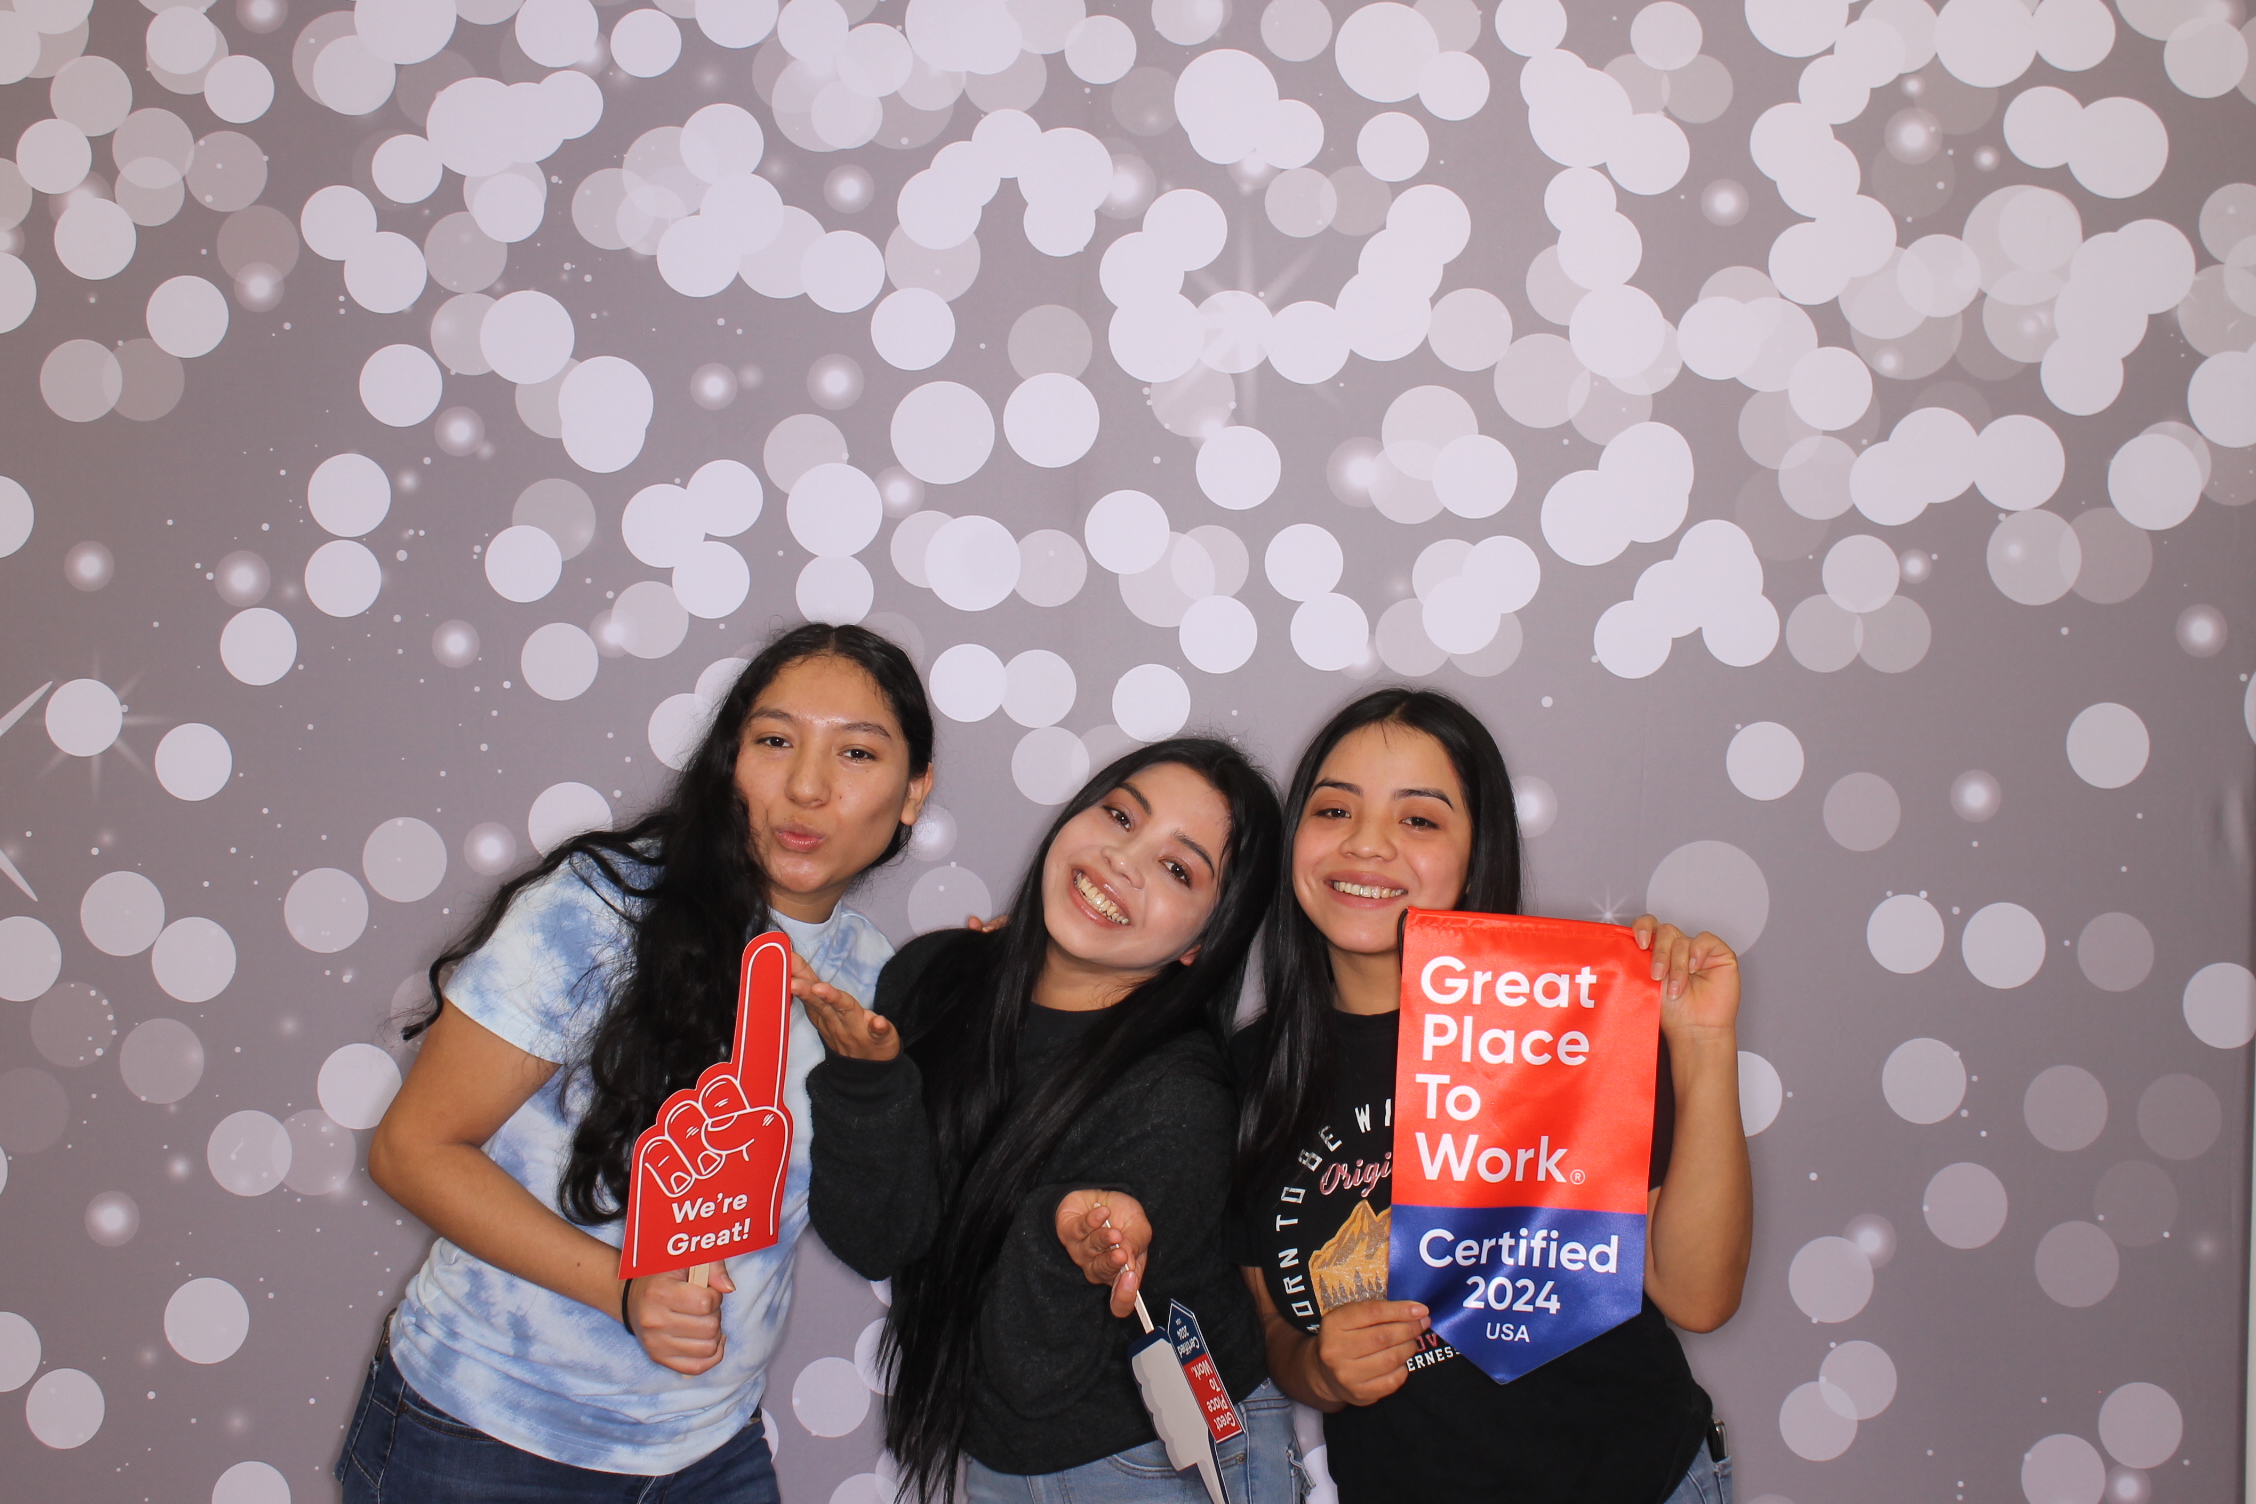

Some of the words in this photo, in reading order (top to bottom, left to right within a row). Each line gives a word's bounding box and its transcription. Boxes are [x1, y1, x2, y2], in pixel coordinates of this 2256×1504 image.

[1420, 955, 1597, 1009] Great
[1422, 1013, 1590, 1066] Place
[1415, 1073, 1481, 1121] To
[1275, 1186, 1306, 1232] TO
[1298, 1125, 1343, 1172] BE
[1354, 1098, 1392, 1133] WI
[1320, 1152, 1392, 1197] Origi
[671, 1192, 748, 1224] We're
[666, 1217, 751, 1256] Great!
[1418, 1227, 1619, 1274] Certified
[1462, 1275, 1561, 1314] 2024
[1176, 1336, 1200, 1358] Certified
[1486, 1322, 1530, 1342] USA
[1406, 1346, 1460, 1372] ERNES
[1206, 1394, 1229, 1413] Place
[1208, 1377, 1221, 1392] To
[1213, 1411, 1236, 1432] Great
